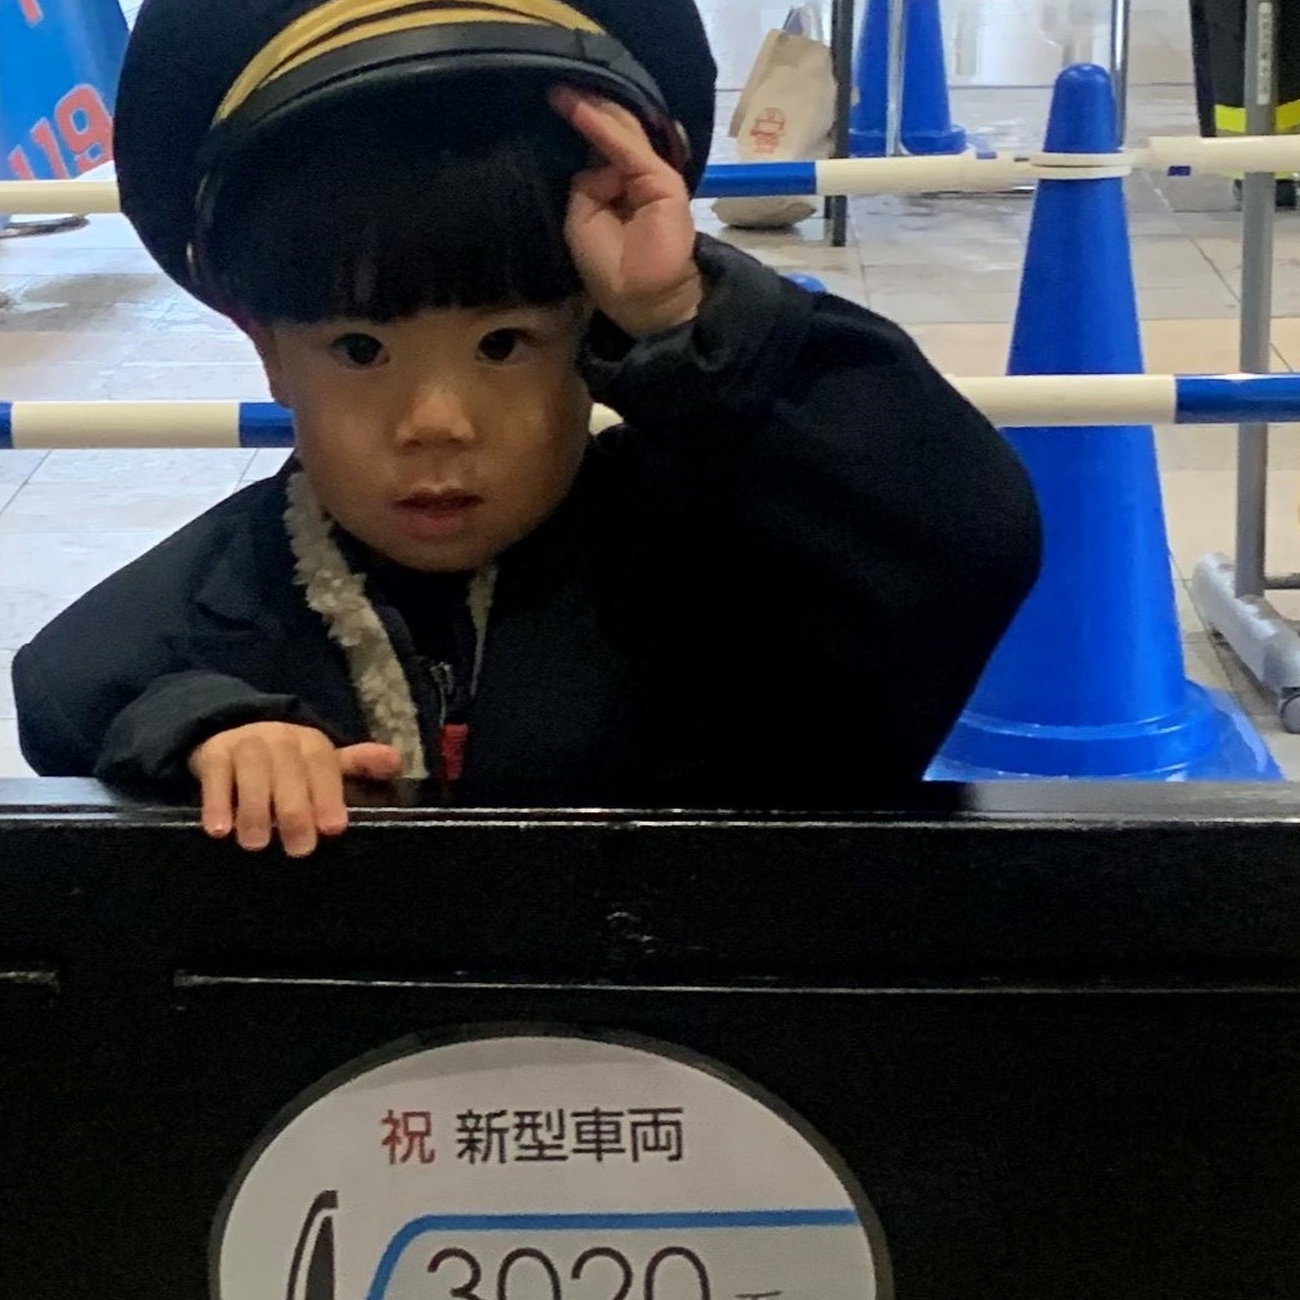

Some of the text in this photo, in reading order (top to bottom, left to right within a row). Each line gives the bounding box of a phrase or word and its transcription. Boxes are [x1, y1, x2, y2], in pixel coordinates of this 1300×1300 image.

[380, 1106, 685, 1165] 祝 新型車両
